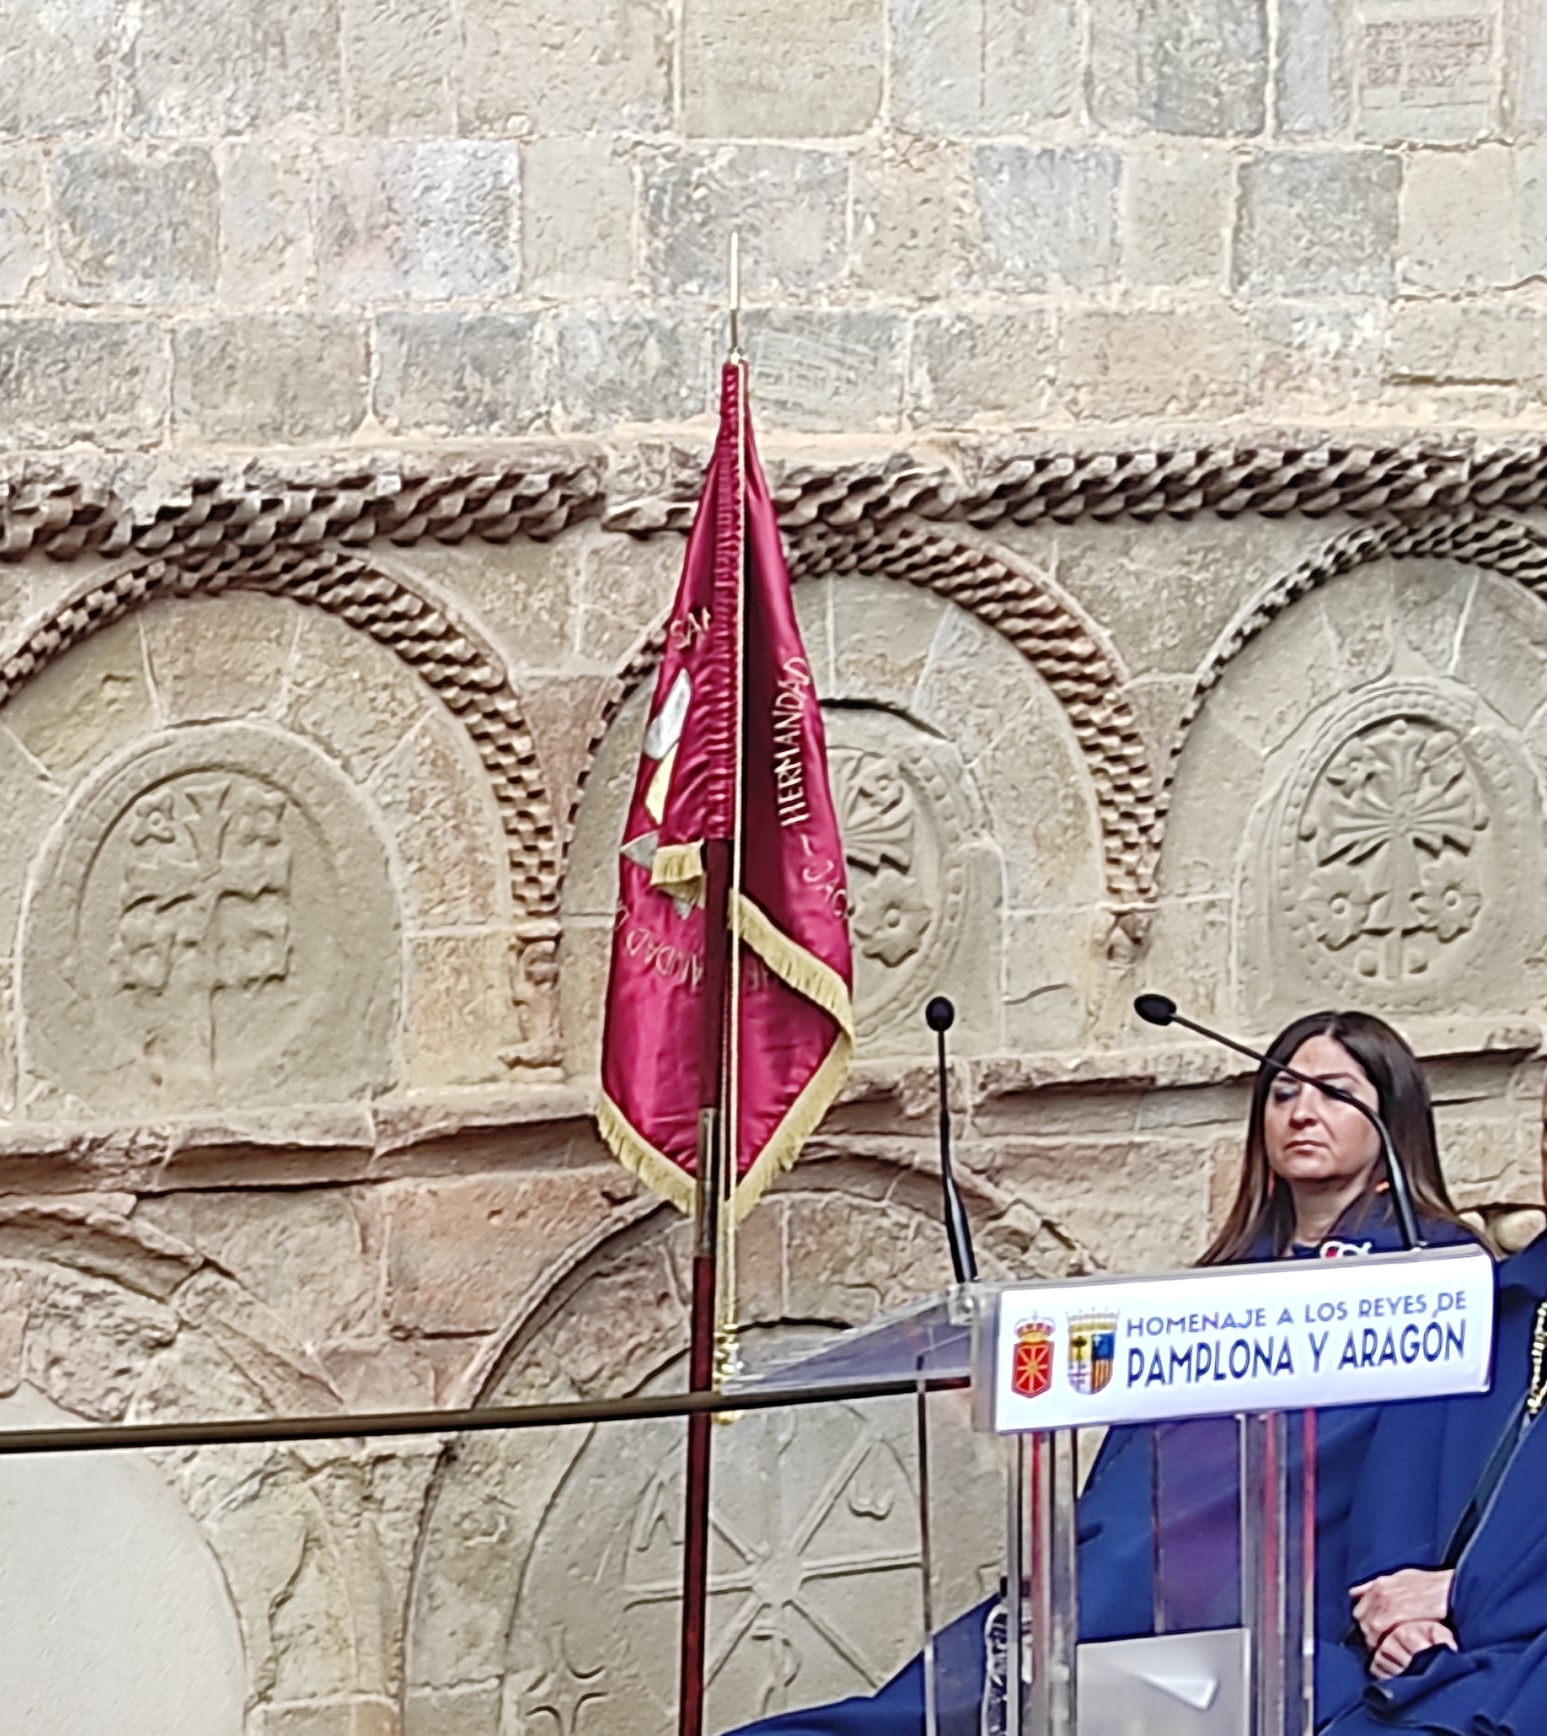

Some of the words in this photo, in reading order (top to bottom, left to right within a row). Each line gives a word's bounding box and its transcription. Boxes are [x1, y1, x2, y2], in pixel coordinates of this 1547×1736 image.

[771, 657, 810, 827] HERMANDAD
[1126, 1308, 1267, 1338] HOMENAJE
[1276, 1307, 1295, 1326] A
[1305, 1301, 1348, 1323] LOS
[1358, 1294, 1427, 1318] REYES
[1437, 1290, 1467, 1311] DE
[1126, 1336, 1295, 1388] PAMPLONA
[1308, 1330, 1330, 1374] Y
[1337, 1311, 1466, 1371] ARAGÓN
